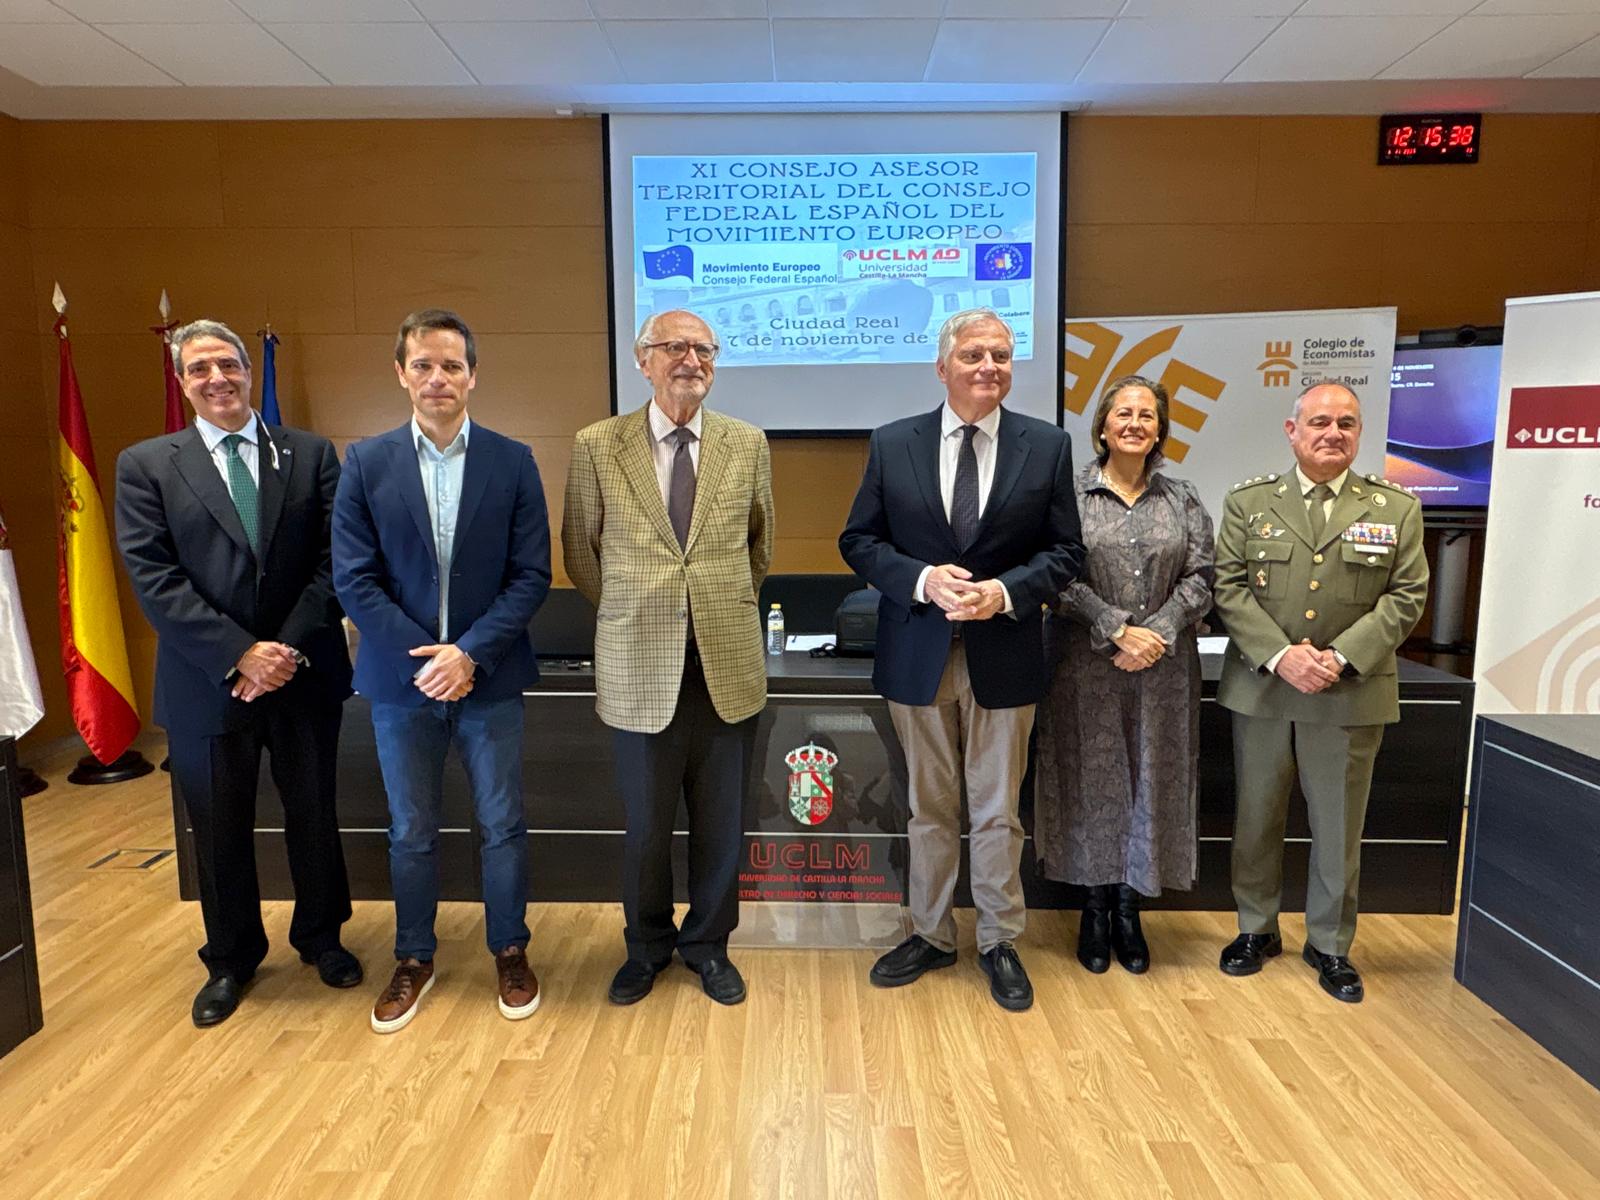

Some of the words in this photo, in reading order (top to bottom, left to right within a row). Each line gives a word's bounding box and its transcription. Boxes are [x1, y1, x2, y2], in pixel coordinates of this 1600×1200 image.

[691, 163, 717, 178] XI
[729, 162, 858, 178] CONSEJO
[869, 161, 979, 177] ASESOR
[638, 184, 825, 200] TERRITORIAL
[837, 183, 892, 199] DEL
[903, 182, 1031, 198] CONSEJO
[665, 205, 798, 221] FEDERAL
[809, 202, 938, 220] ESPAÑOL
[949, 203, 1004, 219] DEL
[667, 226, 856, 243] MOVIMIENTO
[867, 224, 1003, 241] EUROPEO
[859, 249, 928, 261] UCLM
[702, 262, 769, 273] Movimiento
[772, 262, 821, 273] Europeo
[859, 263, 928, 272] Universidad
[702, 275, 747, 286] Consejo
[750, 274, 790, 284] Federal
[794, 273, 837, 285] Español
[769, 317, 846, 330] Ciudad
[855, 316, 899, 329] Real
[727, 335, 739, 347] 7
[746, 335, 772, 346] de
[781, 332, 896, 346] noviembre
[903, 332, 929, 344] de
[1303, 337, 1347, 350] Colegio
[1350, 336, 1365, 348] de
[1303, 348, 1376, 360] Economistas
[750, 843, 870, 870] UCLM
